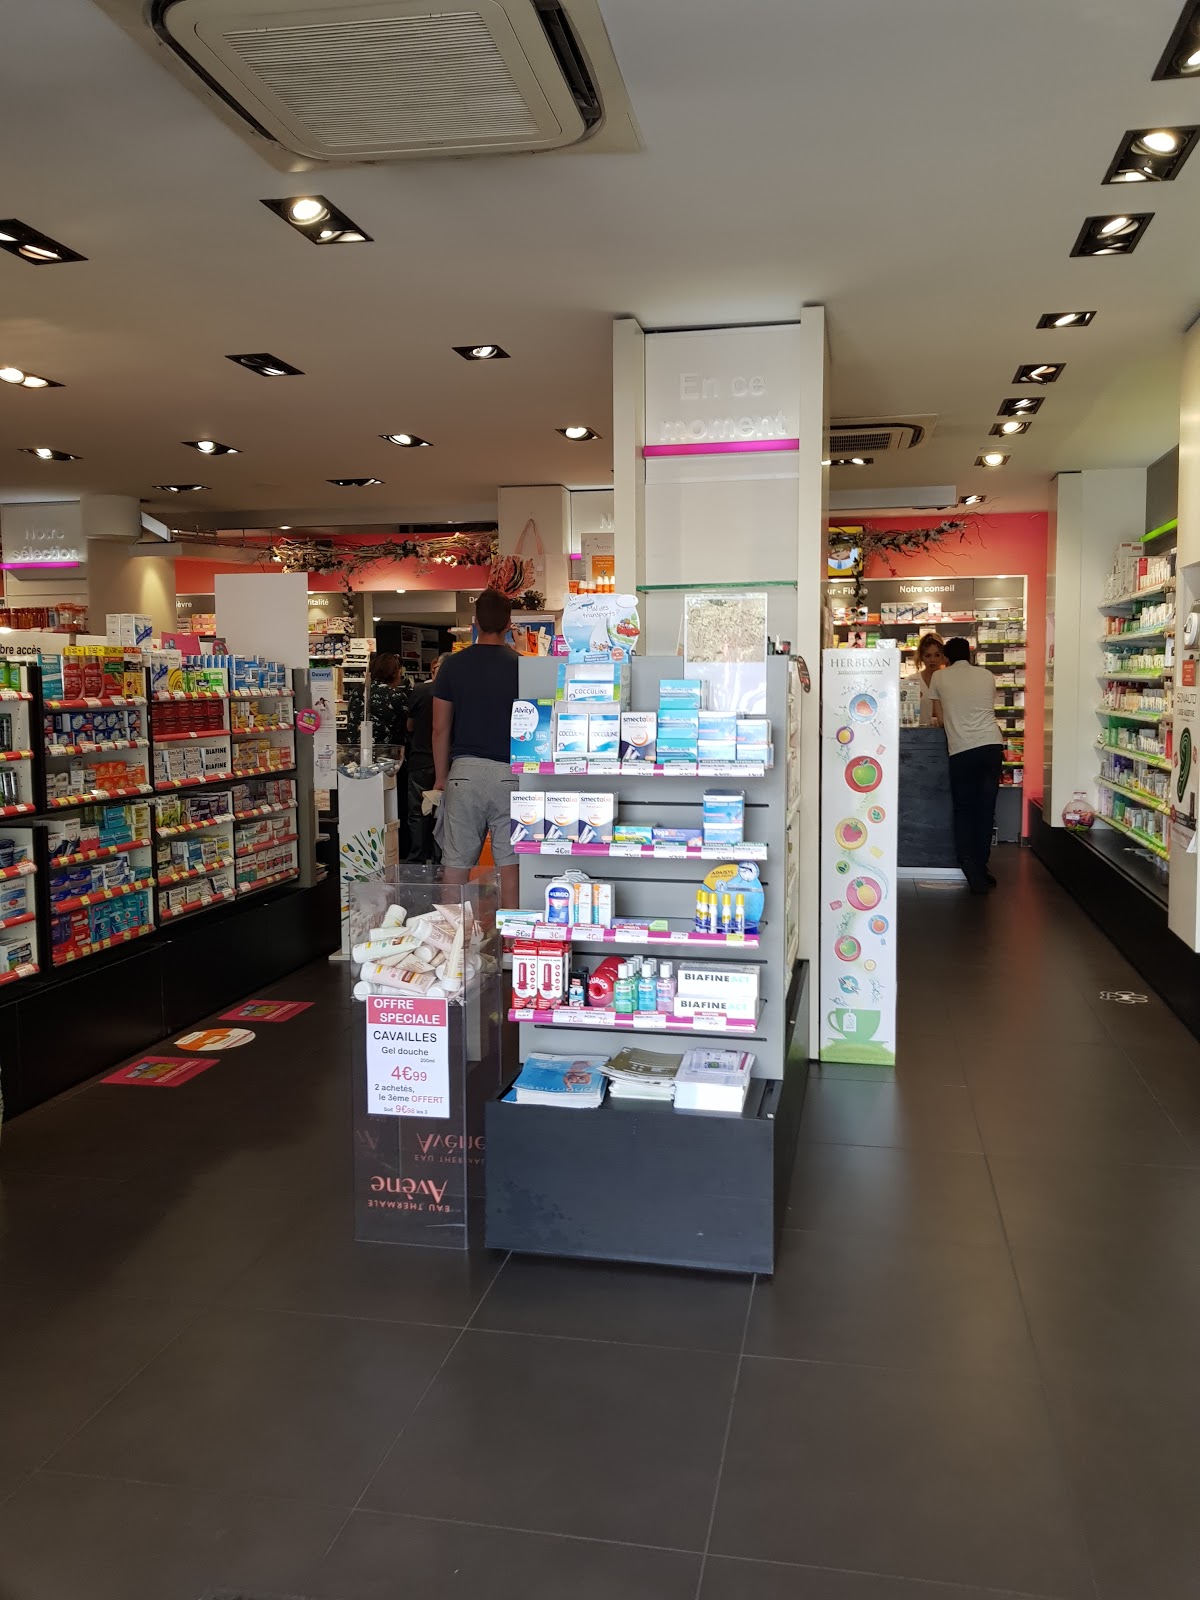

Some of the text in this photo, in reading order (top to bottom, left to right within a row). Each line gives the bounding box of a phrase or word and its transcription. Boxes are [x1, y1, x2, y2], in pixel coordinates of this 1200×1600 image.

[680, 373, 768, 400] En ce
[659, 410, 787, 441] moment
[12, 545, 79, 561] sélection
[924, 584, 954, 592] conseil
[16, 644, 41, 654] accès
[830, 658, 891, 668] HERBESAN
[514, 706, 534, 716] Alvityl
[206, 746, 227, 755] BIAFINE
[206, 762, 227, 771] BIAFINE
[373, 998, 414, 1010] OFFRE
[380, 1012, 440, 1024] SPECIALE
[373, 1030, 437, 1042] CAVAILLES
[398, 1048, 429, 1056] douche
[391, 1066, 427, 1081] 4€99
[381, 1085, 415, 1093] achetés,
[411, 1095, 444, 1104] OFFERT
[370, 1176, 448, 1204] Avène
[368, 1200, 450, 1212] EAU THERMALE
